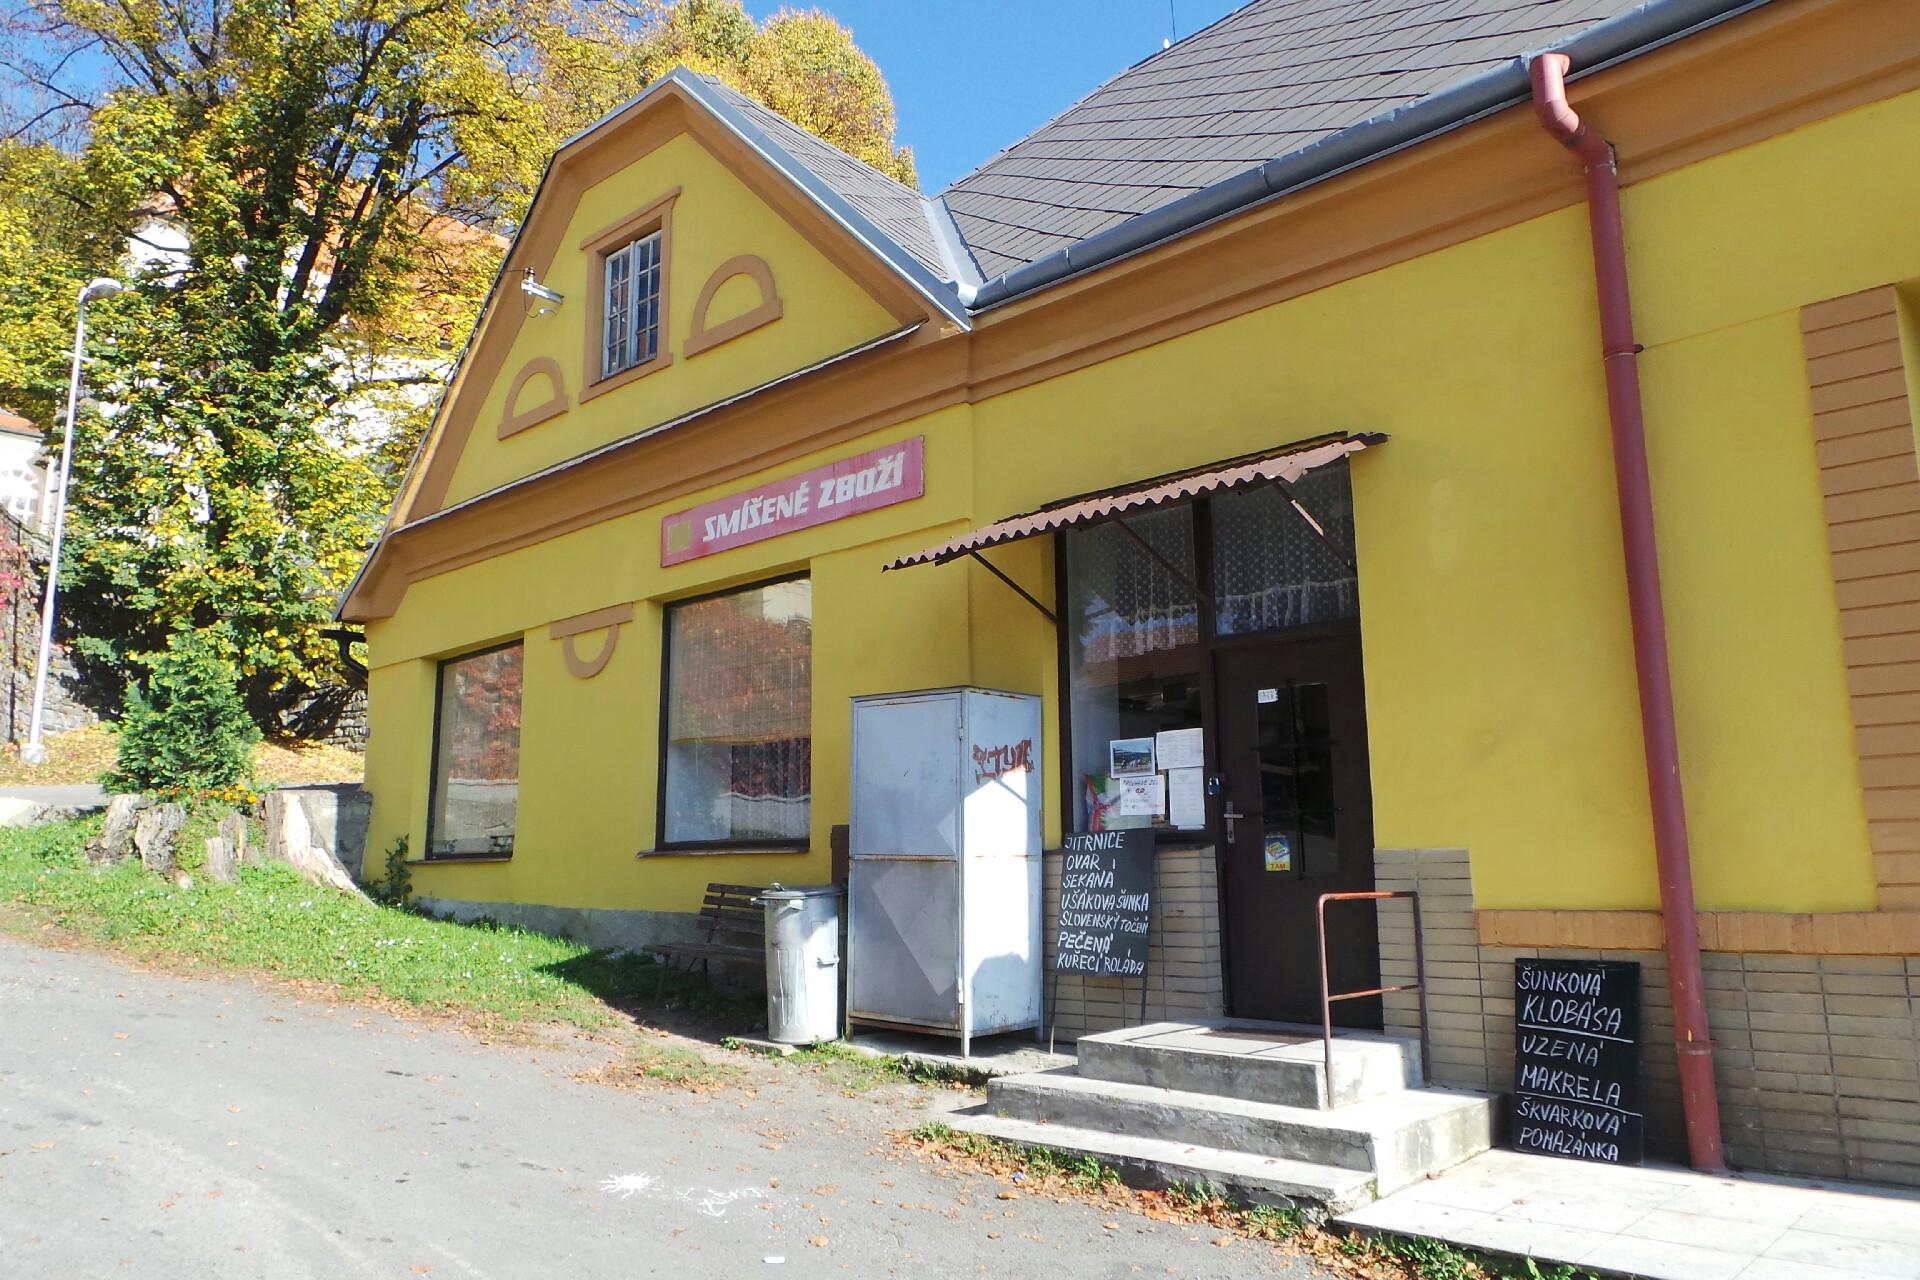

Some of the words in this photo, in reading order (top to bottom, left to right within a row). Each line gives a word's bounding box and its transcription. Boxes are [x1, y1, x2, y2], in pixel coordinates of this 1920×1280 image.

[703, 481, 809, 542] SMÍŠENÉ
[818, 452, 905, 509] ZBOŽÍ
[1065, 832, 1125, 851] JITRNICE
[1067, 854, 1100, 870] OVAR
[1116, 889, 1149, 912] ŠUNKA
[1060, 911, 1120, 930] SLOVENSKÝ
[1058, 931, 1113, 954] PEČENÁ
[1057, 950, 1103, 972] KUŘECÍ
[1104, 949, 1144, 975] ROLÁDA
[1517, 965, 1606, 997] ŠUNKOVÁ
[1523, 994, 1622, 1035] KLOBÁSA
[1522, 1035, 1604, 1068] UZENÁ
[1520, 1064, 1621, 1106] MAKRELA
[1517, 1096, 1626, 1136] ŠKVARKOVÁ
[1520, 1127, 1619, 1161] POMAZÁNKA
